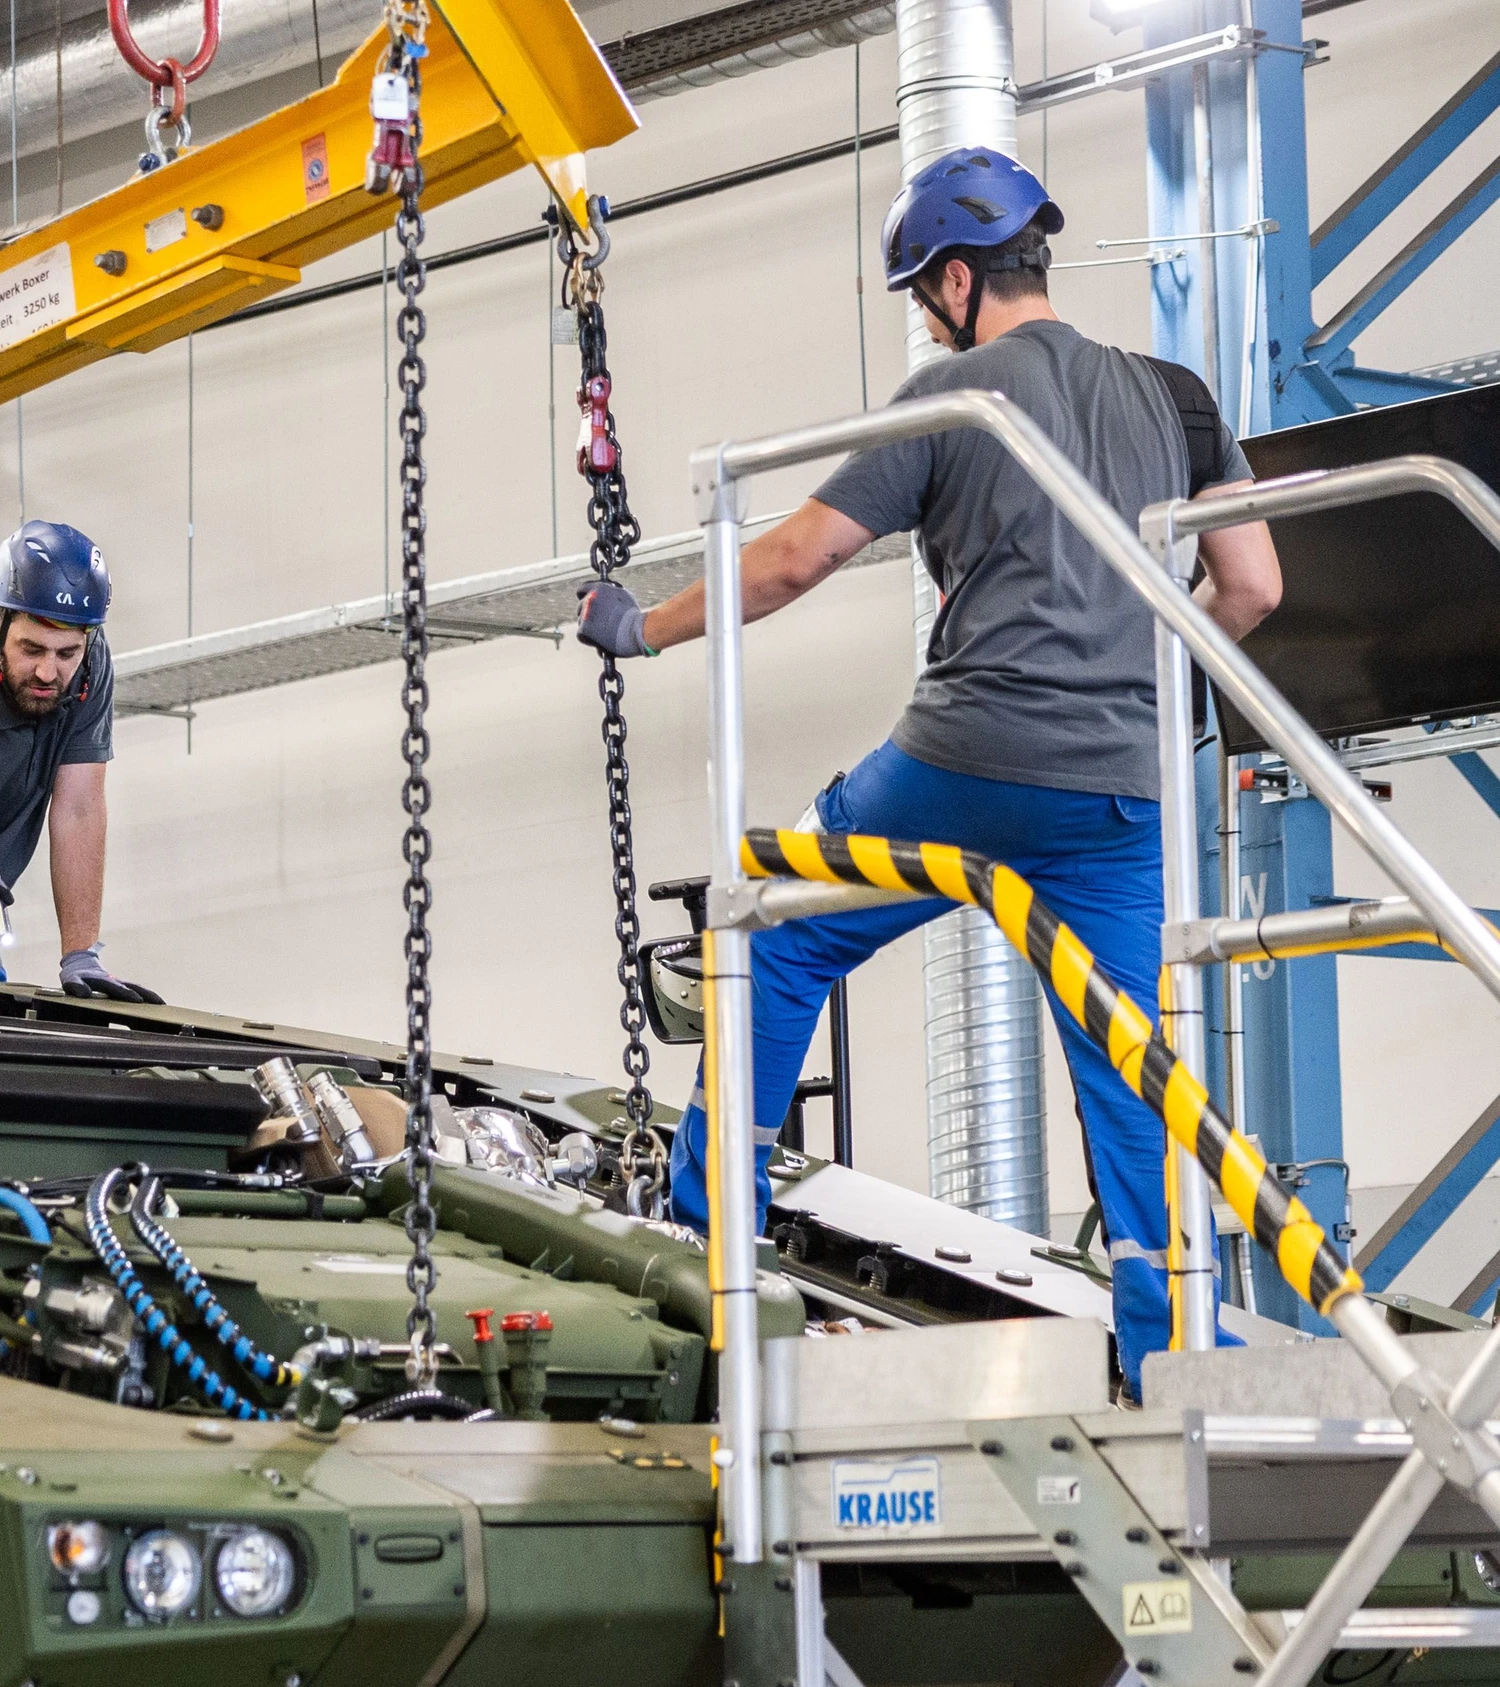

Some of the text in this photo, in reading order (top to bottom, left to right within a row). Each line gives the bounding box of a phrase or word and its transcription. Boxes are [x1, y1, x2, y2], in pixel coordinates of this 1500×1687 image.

[22, 270, 50, 291] Boxer
[24, 298, 47, 318] 3250
[48, 292, 60, 305] kg
[839, 1490, 934, 1526] KRAUSE
